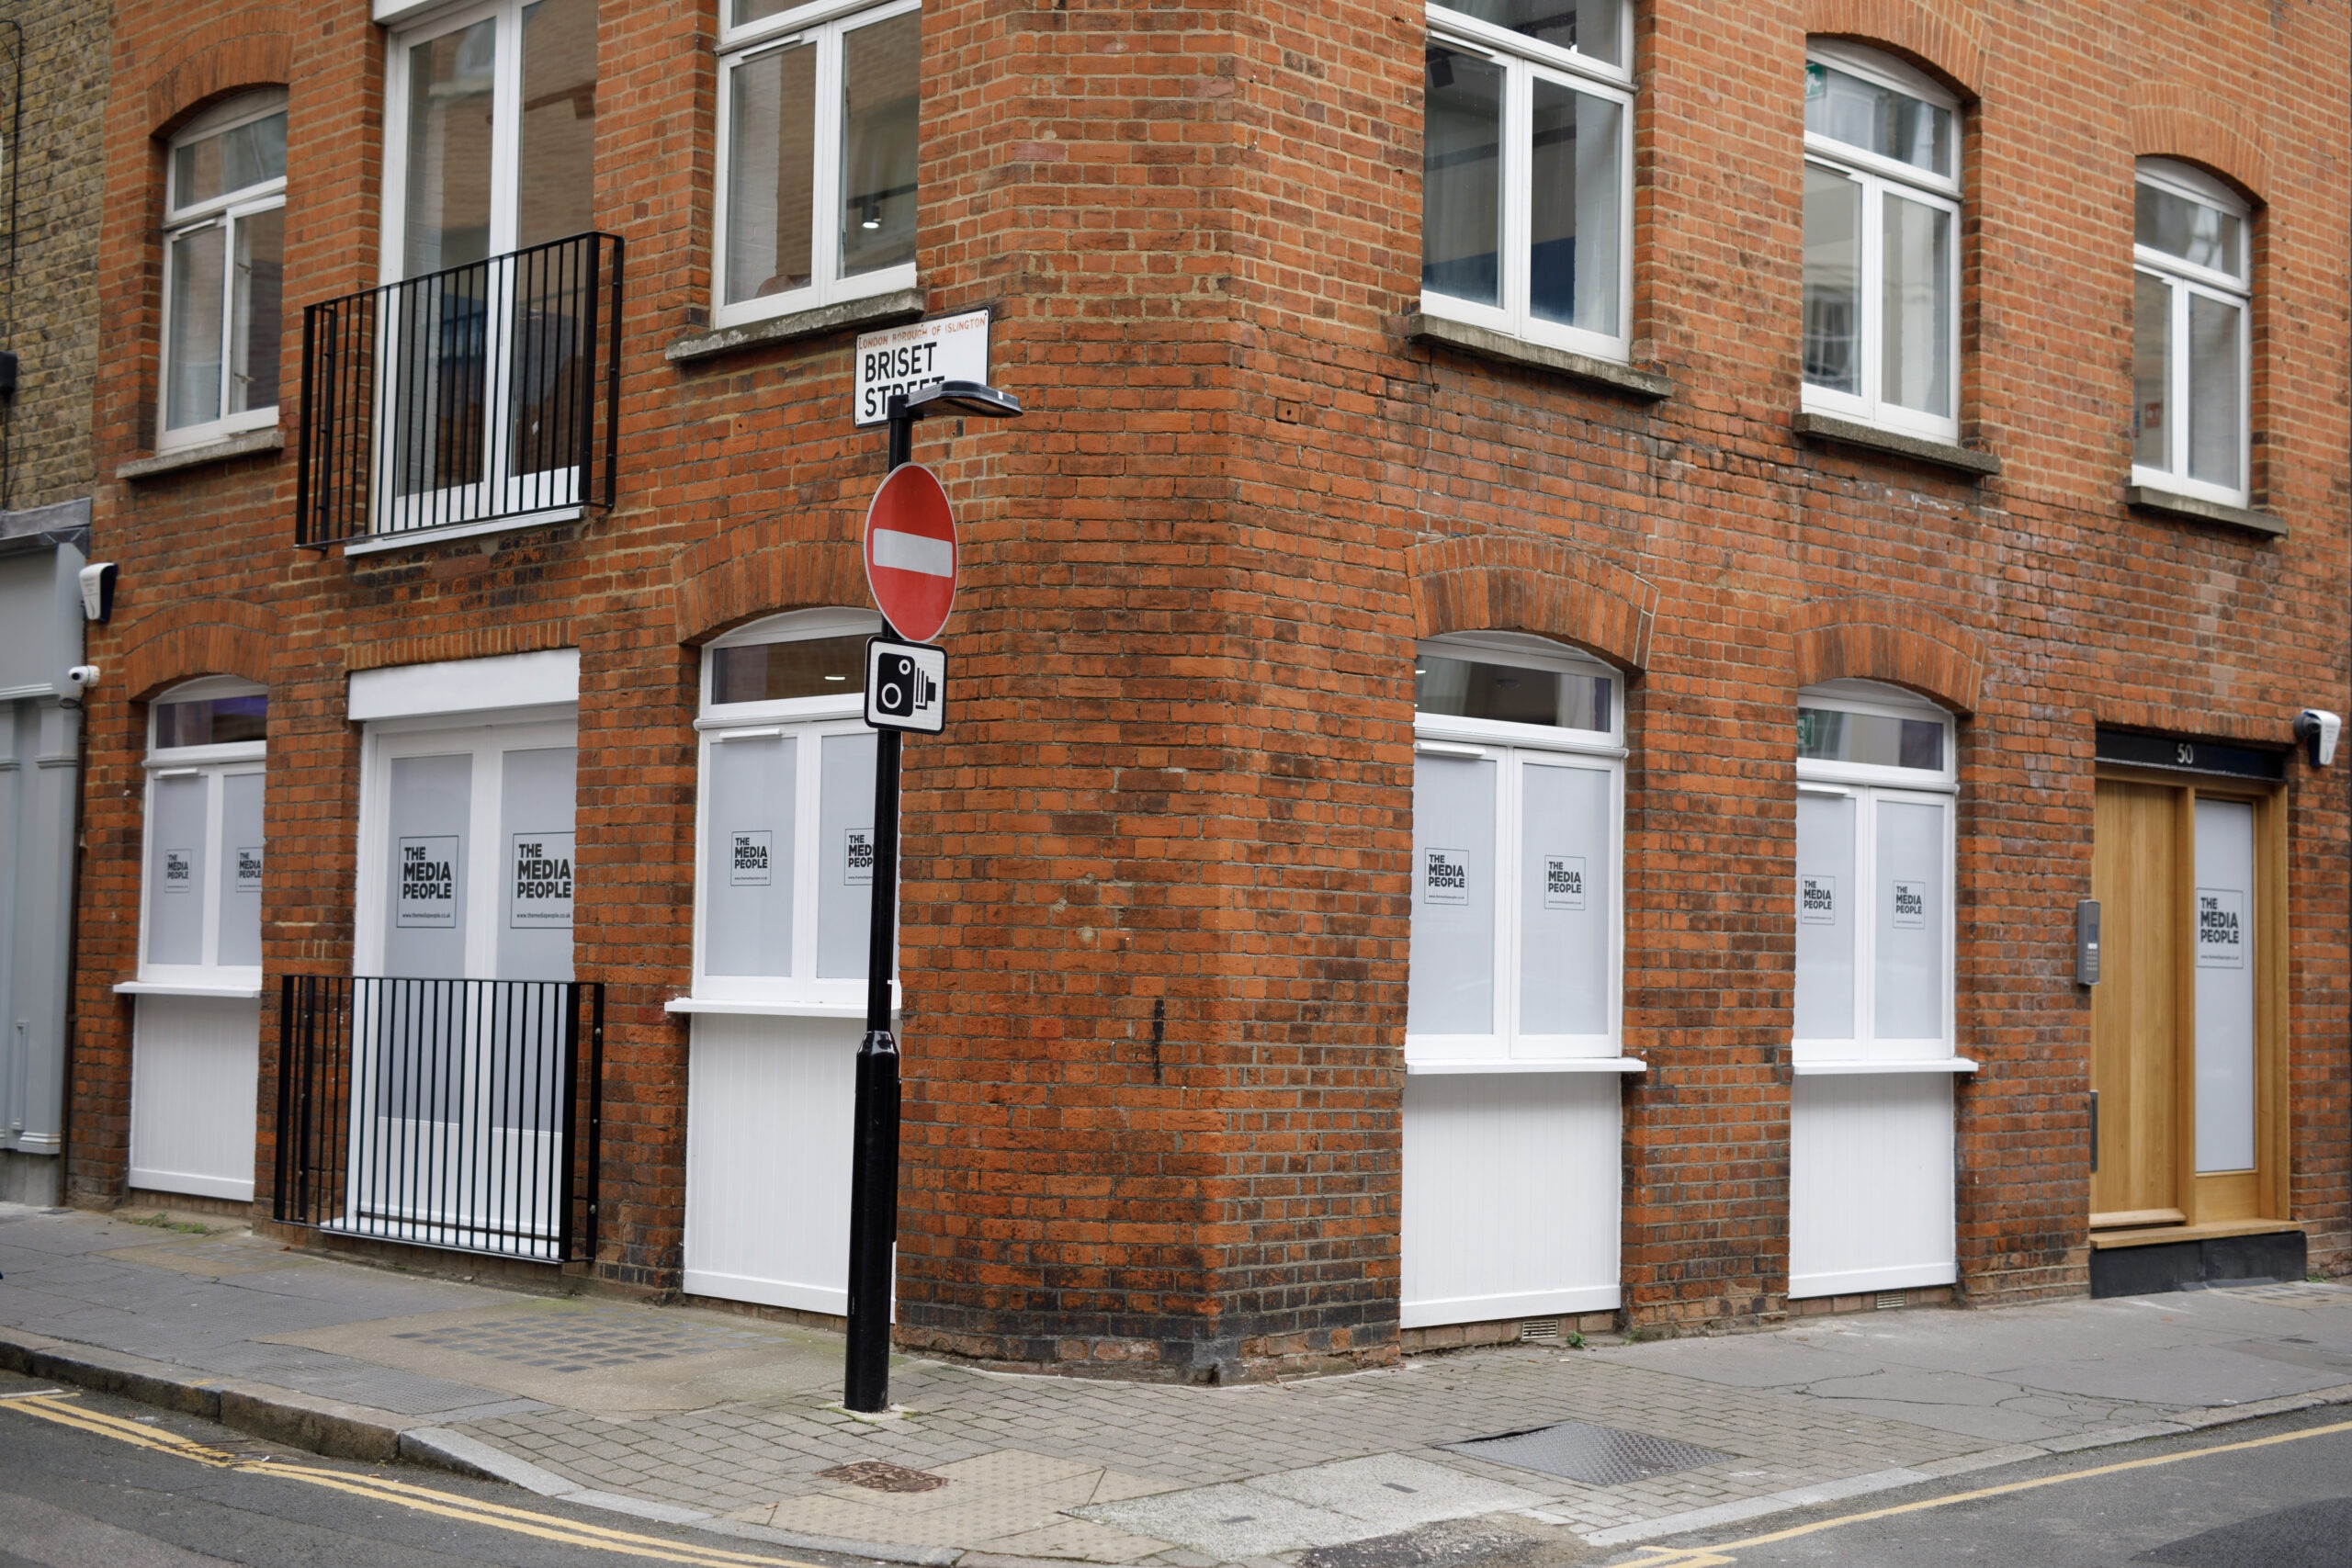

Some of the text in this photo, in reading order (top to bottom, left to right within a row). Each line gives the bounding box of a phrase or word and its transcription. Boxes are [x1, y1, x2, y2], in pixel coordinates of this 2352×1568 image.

[858, 317, 986, 350] LONDON BOROUGH OF ISLINGTON
[865, 341, 937, 383] BRISET
[2177, 742, 2194, 764] 50
[849, 835, 865, 843] THE
[404, 847, 425, 860] THE
[519, 843, 542, 858] THE
[735, 846, 767, 858] MEDIA
[848, 844, 873, 856] MED
[239, 860, 261, 869] MEDIA
[735, 859, 767, 869] PEOPLE
[848, 857, 873, 867] PEOP
[1429, 854, 1444, 864] THE
[167, 862, 189, 871] MEDIA
[403, 862, 451, 881] MEDIA
[518, 859, 571, 880] MEDIA
[1429, 863, 1465, 877] MEDIA
[1549, 862, 1563, 870] THE
[167, 871, 189, 879] PEOPLE
[239, 870, 262, 878] PEOPLE
[1548, 871, 1582, 884] MEDIA
[1428, 876, 1465, 888] PEOPLE
[1804, 880, 1816, 888] THE
[403, 883, 451, 899] PEOPLE
[517, 881, 571, 898] PEOPLE
[1548, 883, 1582, 894] PEOPLE
[1804, 888, 1832, 900] MEDIA
[1896, 886, 1907, 895] THE
[1804, 900, 1833, 910] PEOPLE
[1895, 895, 1922, 905] MEDIA
[2200, 897, 2218, 909] THE
[1895, 905, 1923, 914] PEOPLE
[2200, 911, 2238, 929] MEDIA
[2200, 929, 2239, 944] PEOPLE
